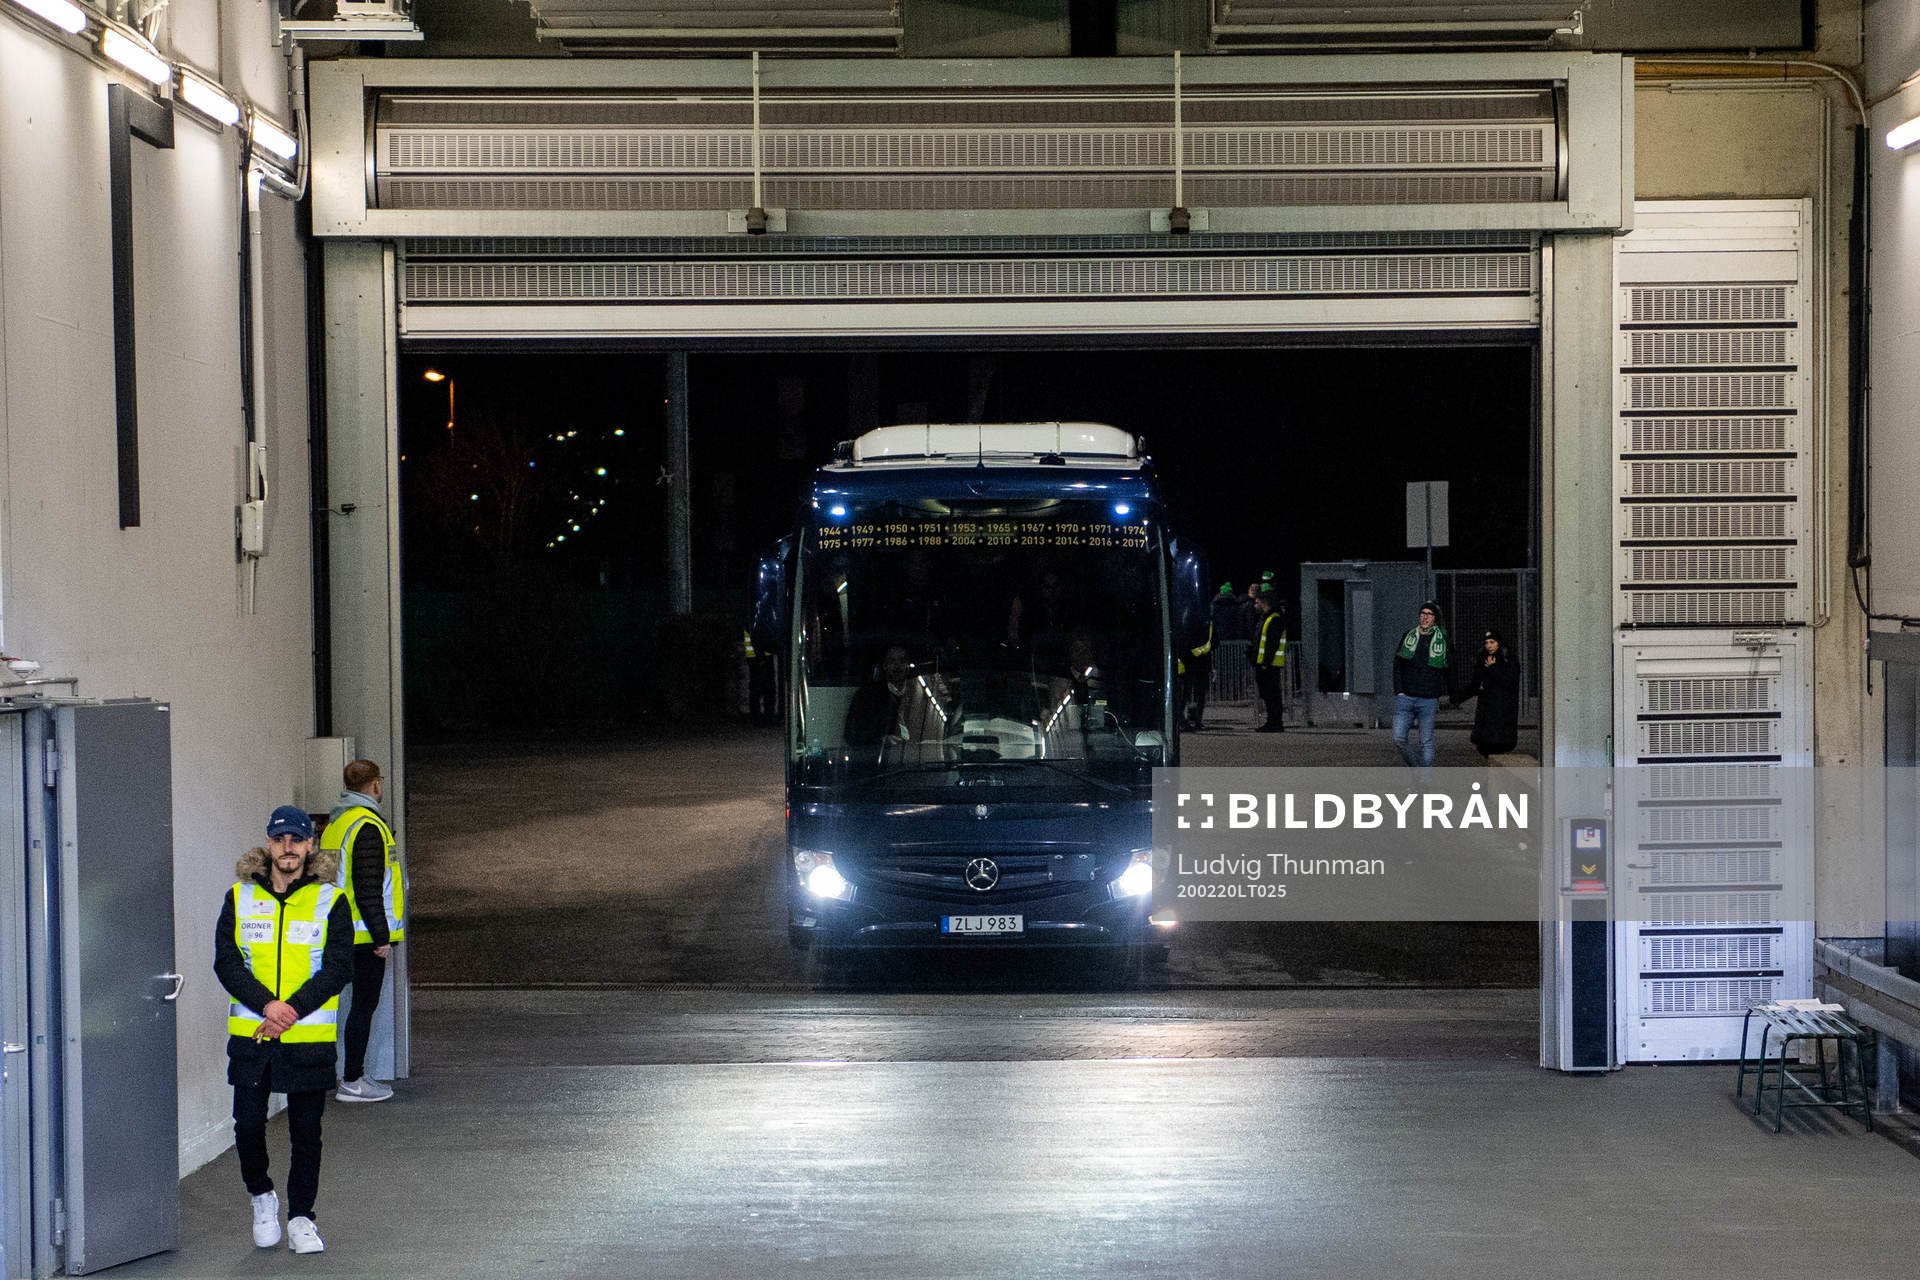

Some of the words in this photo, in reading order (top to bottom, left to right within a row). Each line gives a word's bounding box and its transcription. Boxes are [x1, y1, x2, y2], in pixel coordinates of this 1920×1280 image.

[818, 527, 841, 537] 1944
[851, 525, 874, 535] 1949
[884, 524, 908, 533] 1950
[918, 523, 941, 533] 1951
[952, 523, 976, 533] 1953
[987, 523, 1011, 532] 1965
[1021, 523, 1045, 532] 1967
[1055, 523, 1079, 533] 1970
[1089, 524, 1112, 534] 1971
[1122, 526, 1145, 535] 1974
[818, 540, 841, 550] 1975
[851, 538, 874, 548] 1977
[884, 537, 908, 546] 1986
[918, 536, 942, 546] 1988
[952, 536, 976, 546] 2004
[987, 536, 1011, 545] 2010
[1021, 536, 1045, 545] 2013
[1055, 536, 1079, 545] 2014
[1089, 537, 1112, 546] 2016
[1122, 539, 1145, 549] 2017
[241, 922, 272, 930] ORDNER
[955, 917, 983, 930] ZLJ
[987, 917, 1017, 930] 983
